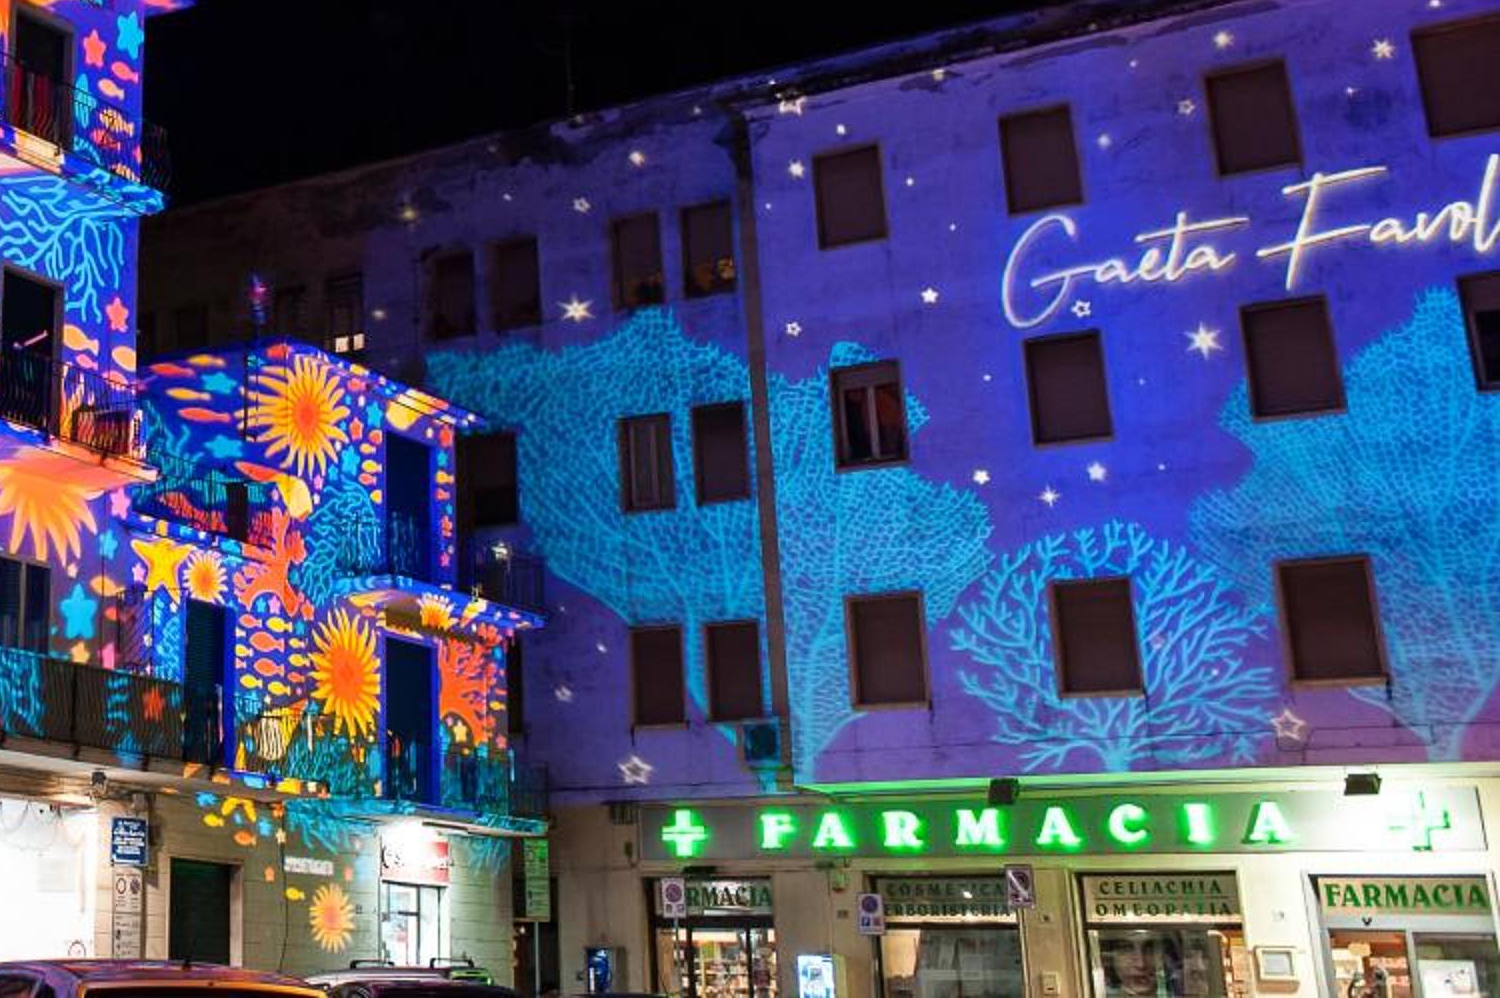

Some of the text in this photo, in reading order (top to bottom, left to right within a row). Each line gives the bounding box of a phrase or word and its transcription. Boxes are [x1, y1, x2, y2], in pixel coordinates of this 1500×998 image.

[1002, 212, 1250, 328] Gaeta
[759, 801, 1296, 850] FARMACIA
[686, 886, 772, 907] RMACIA
[1100, 879, 1221, 895] CELIACHIA
[1324, 883, 1489, 908] FARMACIA
[1095, 903, 1231, 916] OMEOPATIA
